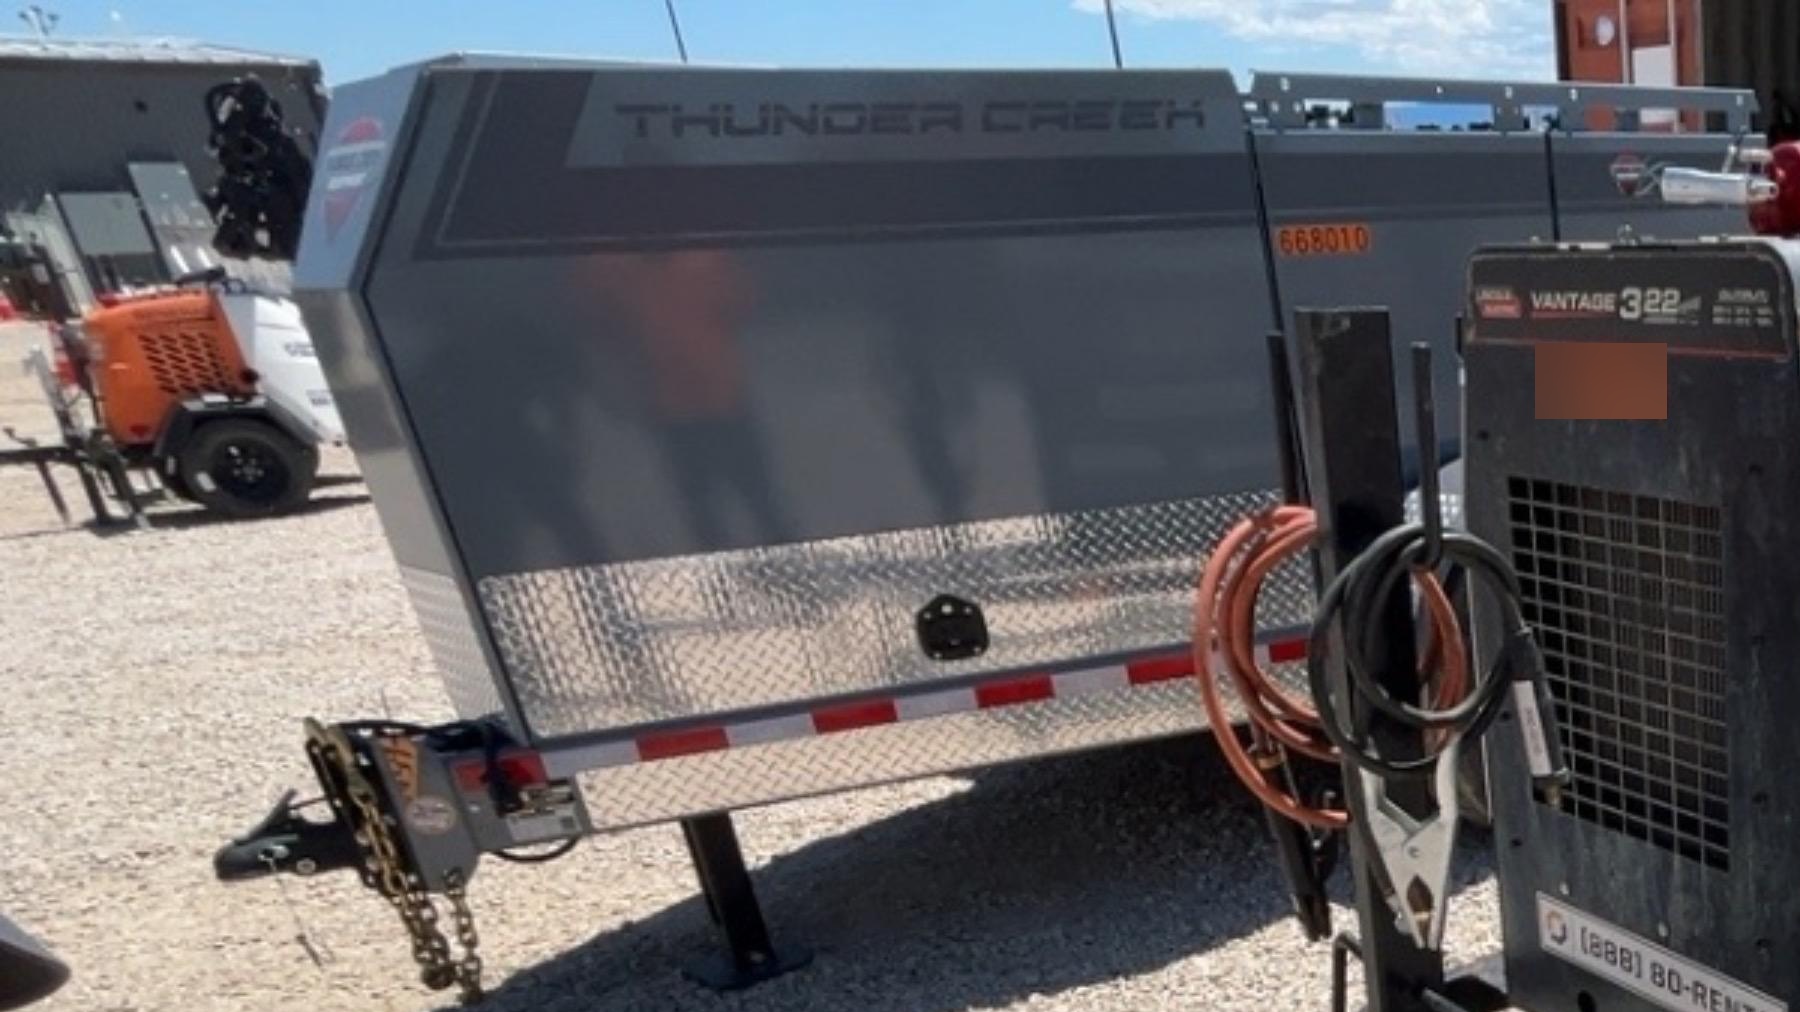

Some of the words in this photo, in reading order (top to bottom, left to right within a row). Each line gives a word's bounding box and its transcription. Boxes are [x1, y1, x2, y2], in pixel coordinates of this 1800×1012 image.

[616, 102, 963, 138] THUNDER
[981, 99, 1206, 132] CREEK
[1280, 226, 1369, 254] 668010
[1530, 290, 1616, 313] VANTAGE
[1619, 287, 1681, 319] 322
